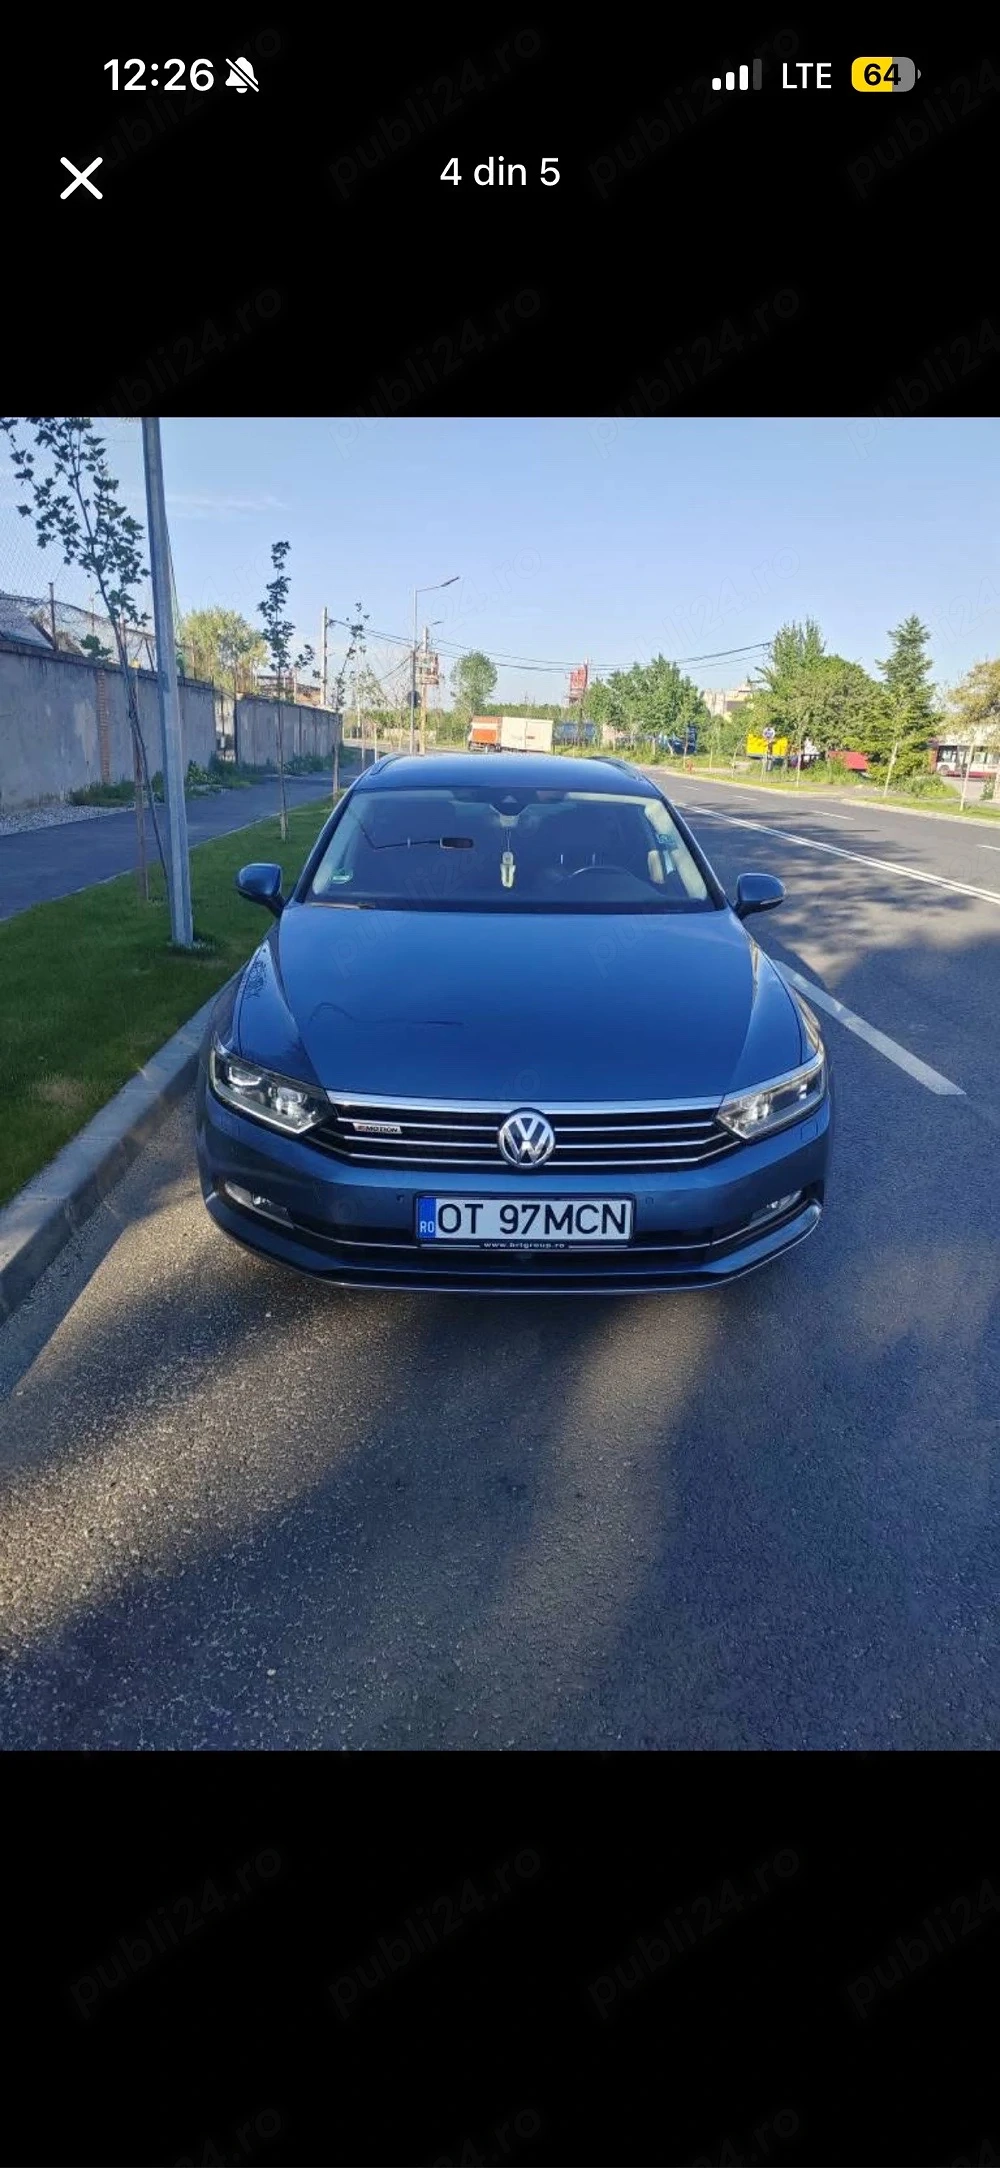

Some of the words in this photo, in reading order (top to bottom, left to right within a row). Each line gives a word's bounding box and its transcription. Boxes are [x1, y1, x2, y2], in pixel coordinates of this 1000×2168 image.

[420, 1221, 435, 1234] RO
[438, 1204, 484, 1234] OT
[499, 1204, 626, 1235] 97MCN
